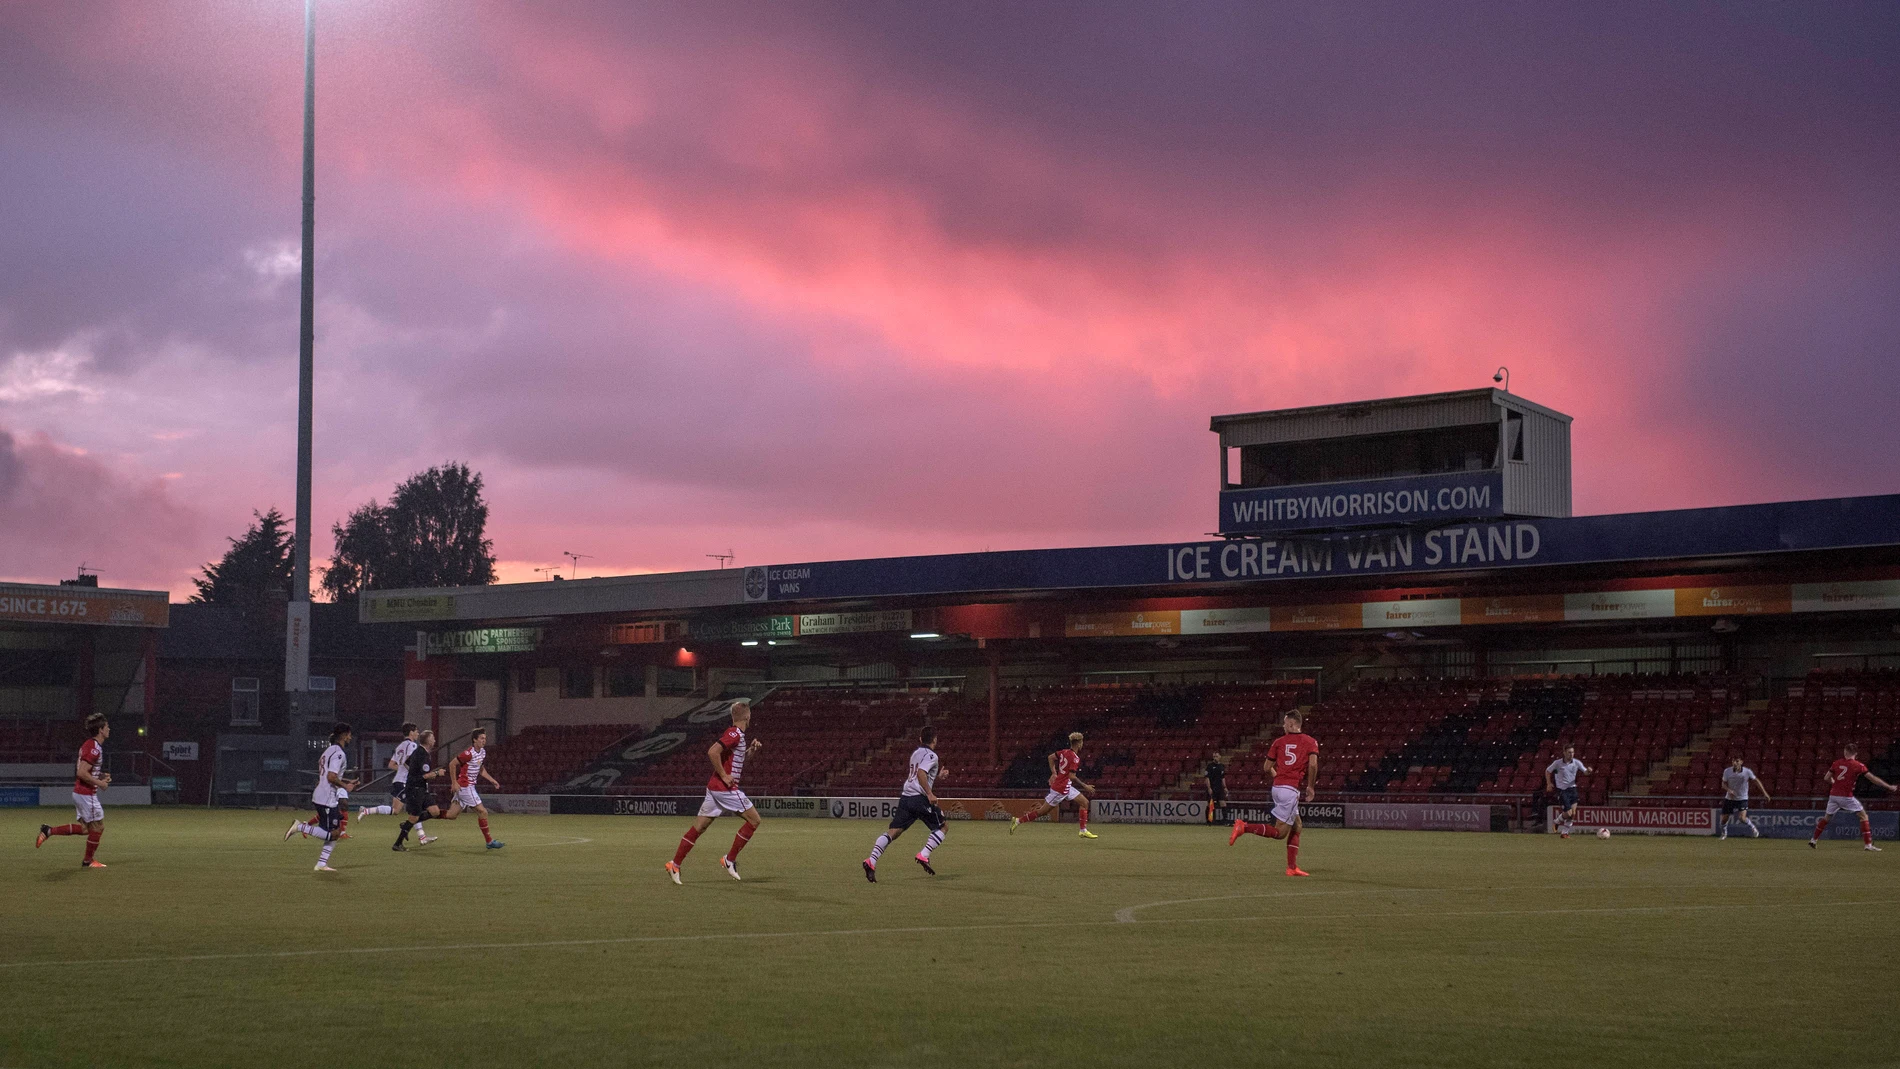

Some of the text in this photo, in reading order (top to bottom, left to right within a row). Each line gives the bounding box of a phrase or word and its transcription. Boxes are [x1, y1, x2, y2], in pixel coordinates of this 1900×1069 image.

[1232, 485, 1491, 523] WHITBYMORRISON.COM
[1168, 523, 1540, 580] ICE CREAM VAN STAND
[769, 568, 811, 581] ICE CREAM
[779, 583, 800, 594] VANS
[0, 597, 88, 616] SINCE 1675
[731, 620, 769, 634] Business
[771, 617, 791, 631] Park
[801, 616, 835, 627] Graham
[427, 629, 489, 648] CLAYTONS
[1284, 744, 1297, 766] 5
[1837, 765, 1848, 781] 2
[634, 801, 655, 815] RADIO
[656, 801, 677, 815] STOKE
[774, 798, 814, 810] Cheshire
[849, 802, 878, 817] Blue
[1098, 802, 1201, 817] MARTIN&CO
[1308, 806, 1343, 818] 664642
[1352, 809, 1408, 820] TIMPSON
[1421, 809, 1480, 822] TIMPSON
[1638, 811, 1710, 826] MARQUEES
[1835, 826, 1859, 836] 01270
